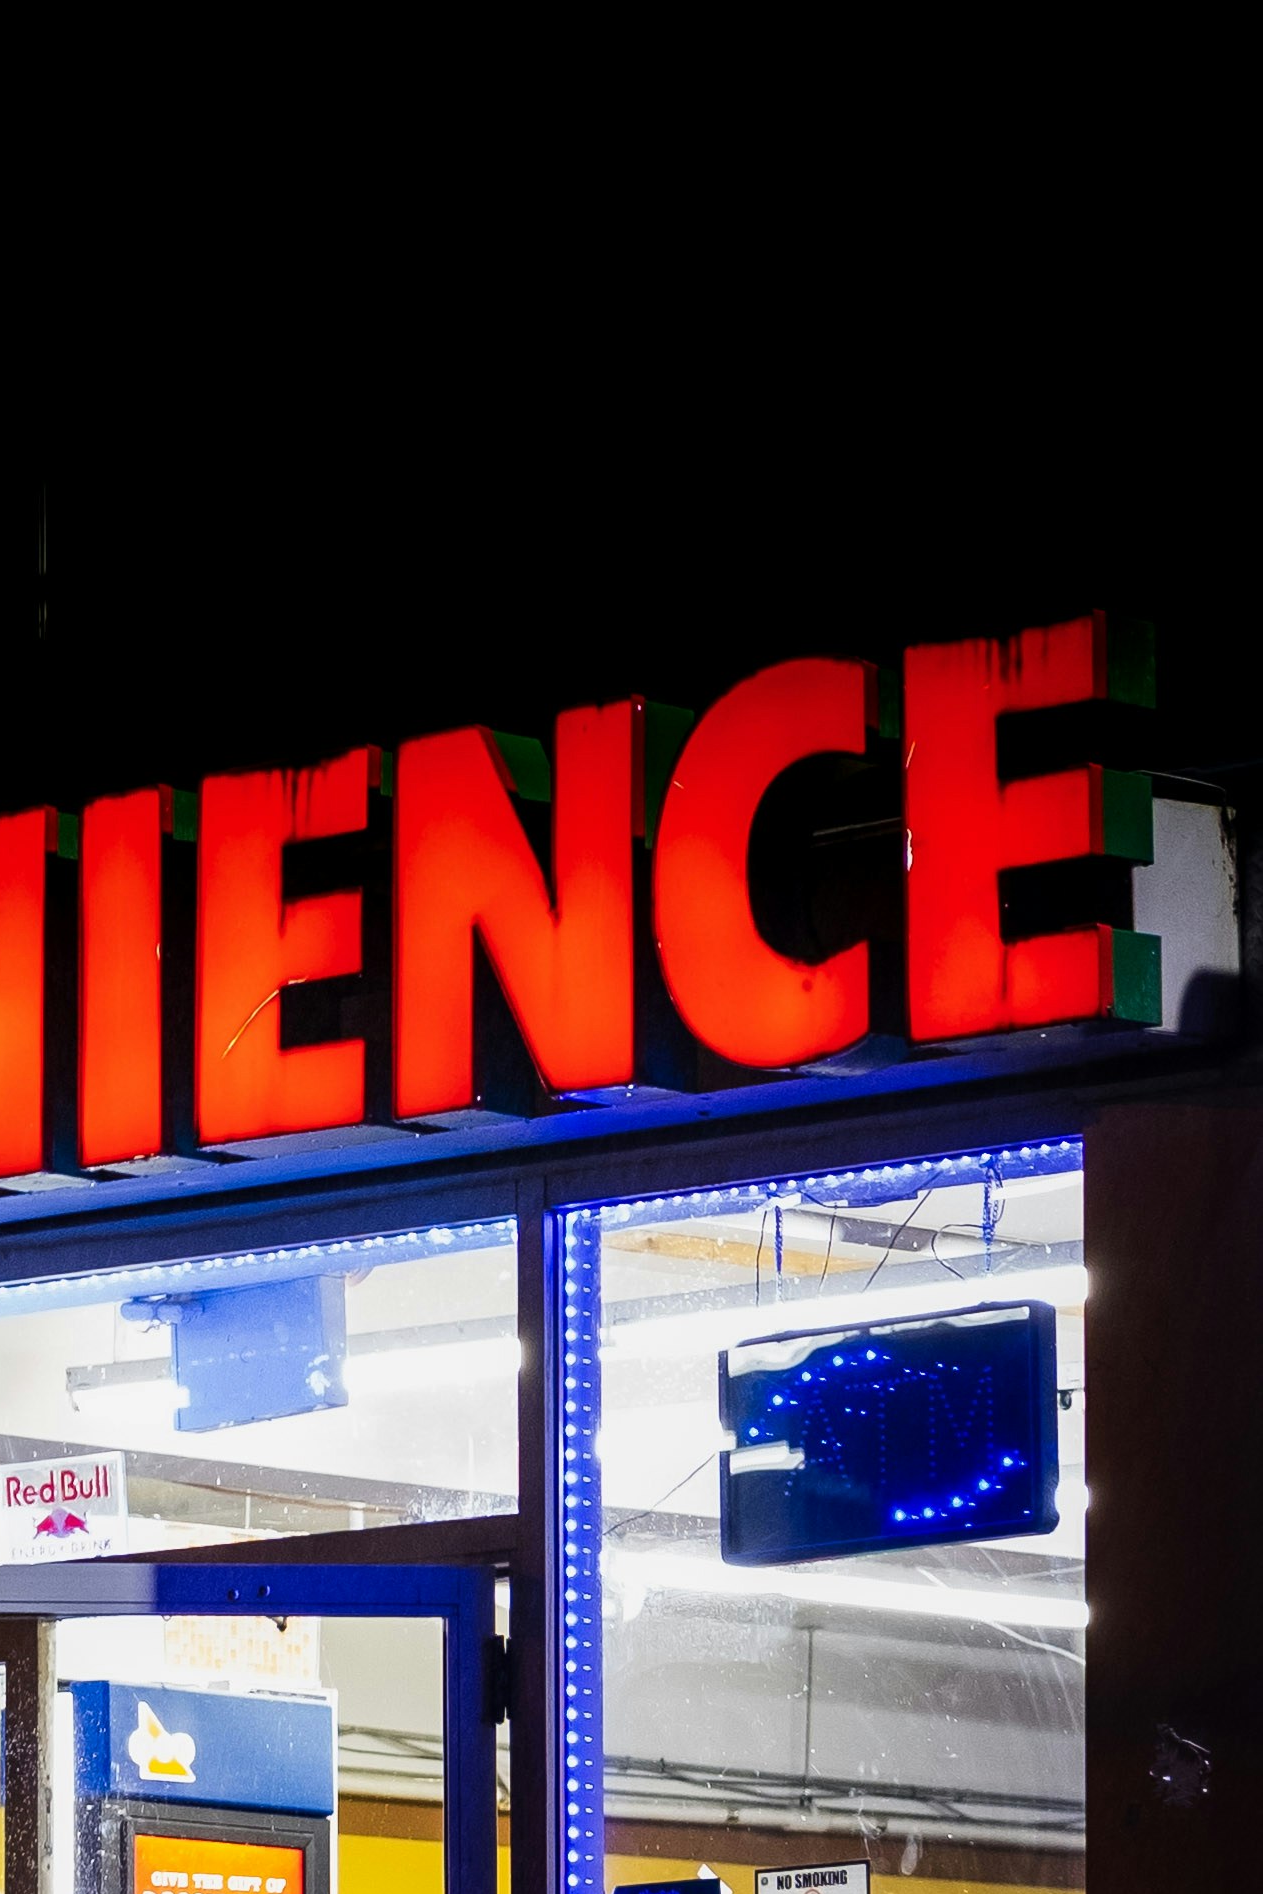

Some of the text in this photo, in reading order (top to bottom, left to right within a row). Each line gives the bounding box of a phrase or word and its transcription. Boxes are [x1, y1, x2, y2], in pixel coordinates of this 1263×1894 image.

[6, 1465, 109, 1507] Red Bull
[151, 1871, 286, 1893] GIVE THE GIFT OF
[777, 1869, 848, 1890] NO SMOKING
